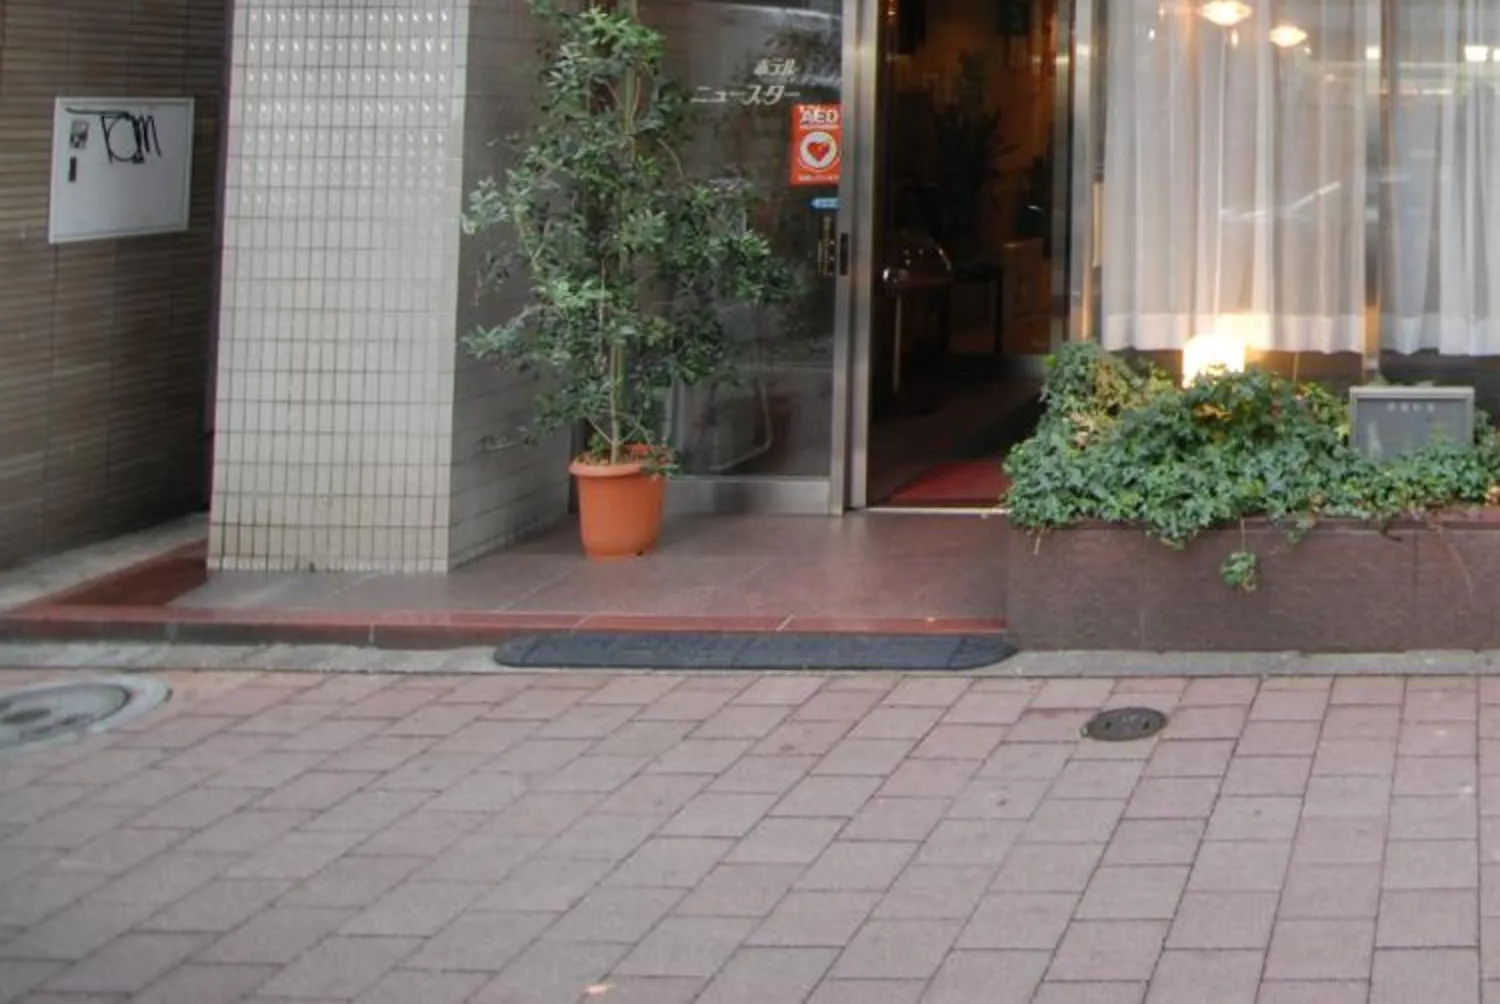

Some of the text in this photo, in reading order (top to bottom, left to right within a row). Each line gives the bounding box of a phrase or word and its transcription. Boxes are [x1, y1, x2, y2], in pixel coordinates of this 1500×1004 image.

[691, 84, 800, 105] ニュースター
[800, 106, 838, 124] AED
